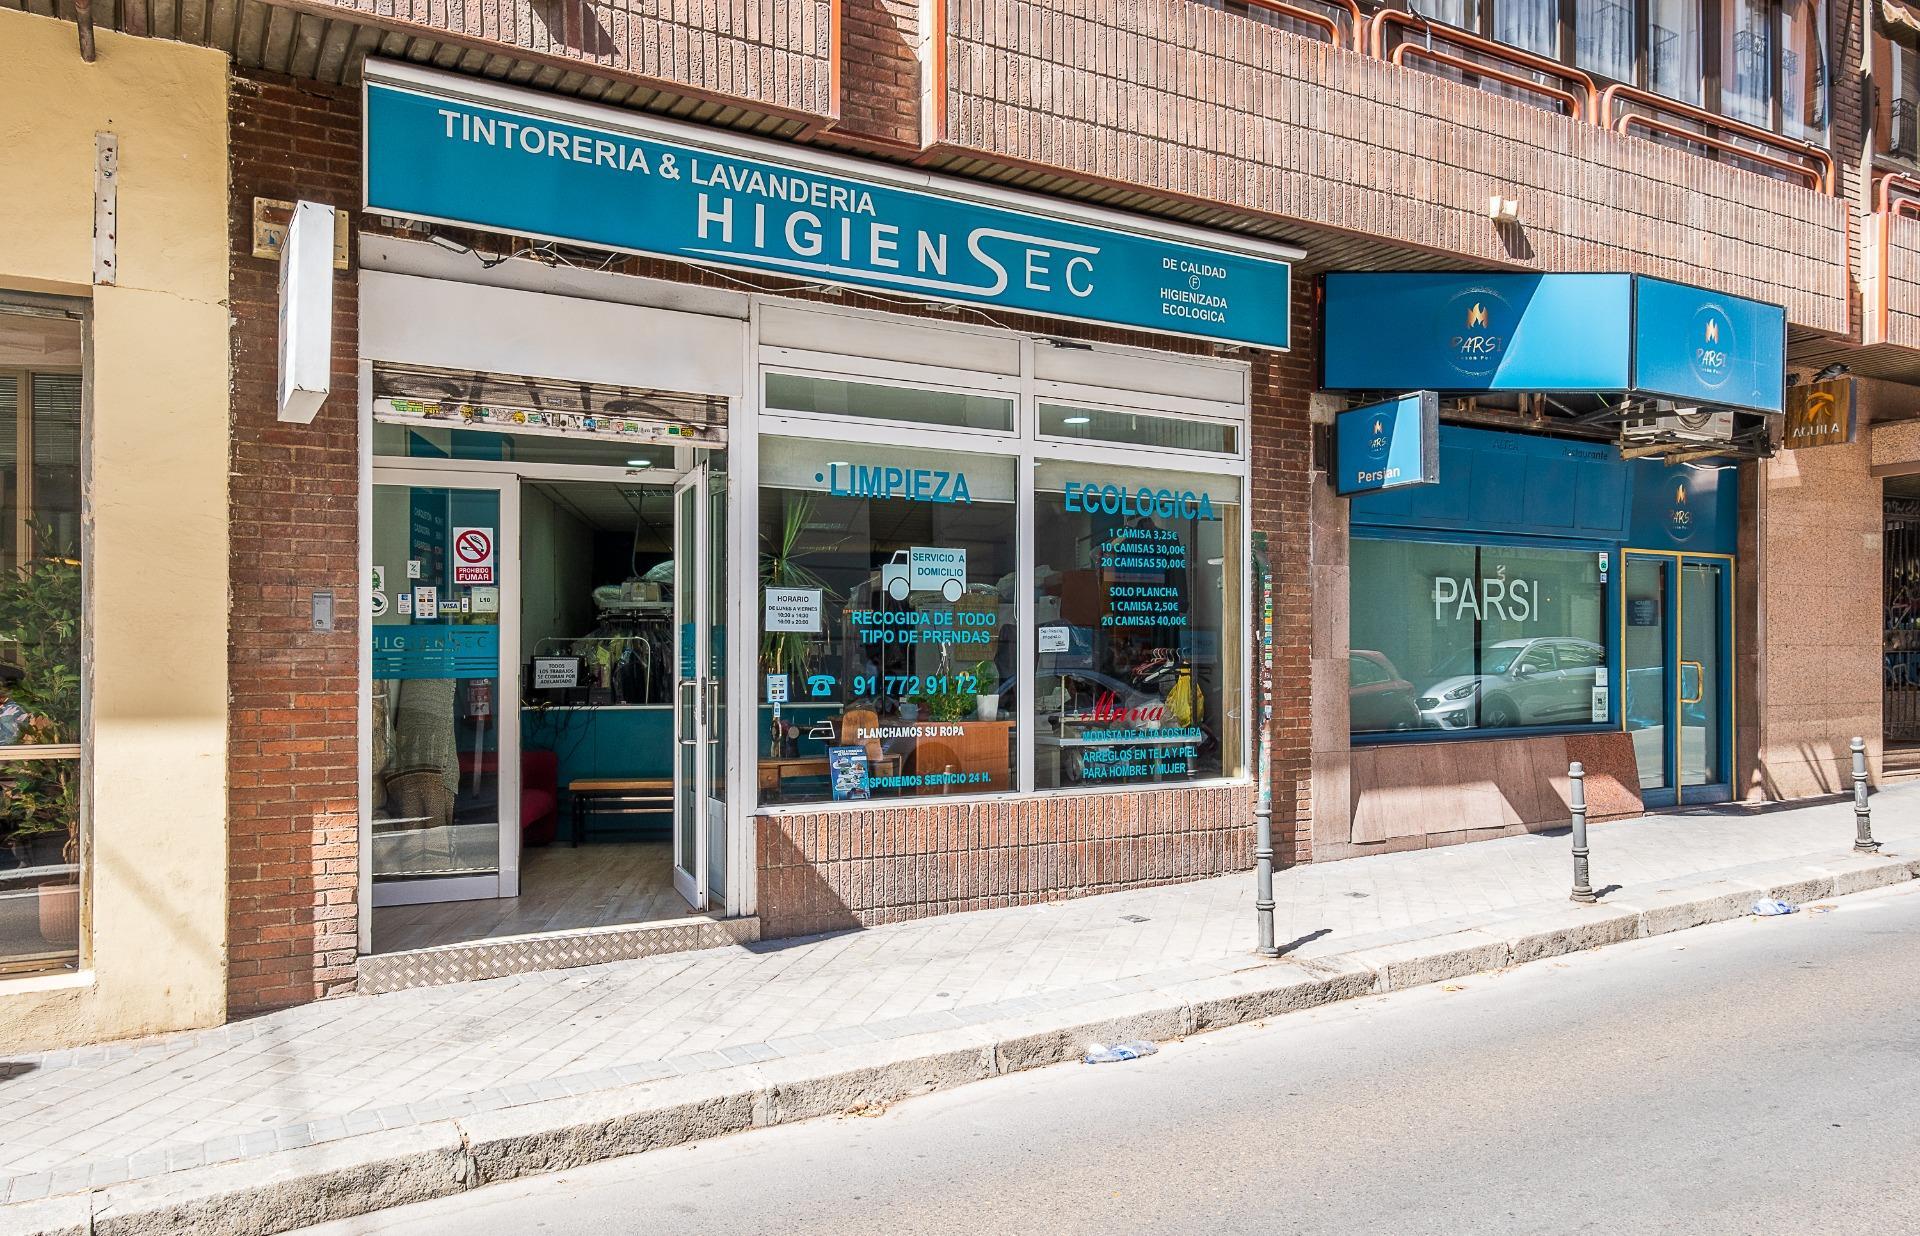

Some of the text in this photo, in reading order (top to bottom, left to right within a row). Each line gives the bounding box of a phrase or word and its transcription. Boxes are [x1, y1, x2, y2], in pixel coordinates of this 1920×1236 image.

[438, 109, 876, 216] TINTORERIA & LAVANDERIA
[1163, 257, 1227, 279] DE CALIDAD
[1160, 288, 1228, 309] HIGIENIZADA
[1162, 303, 1225, 323] ECOLOGICA
[1358, 467, 1400, 483] Persian
[831, 464, 972, 504] LIMPIEZA
[1065, 481, 1215, 521] ECOLOGICA
[1109, 528, 1178, 540] 1 CAMISA 3,25€
[1101, 543, 1186, 555] 10 CAMISAS 30,00€
[912, 552, 965, 563] SERVICIO A
[1101, 557, 1186, 569] 20 CAMISAS 50,00€
[459, 573, 489, 581] FUMAR
[917, 567, 964, 577] DOMICILIO
[1110, 587, 1178, 597] SOLO PLANCHA
[1435, 577, 1538, 621] PARSI
[1110, 601, 1179, 612] 1 CAMISA 2,50€
[852, 611, 996, 626] RECOGIDA DE TODO
[1102, 616, 1187, 627] 20 CAMISAS 40,00€
[860, 630, 990, 644] TIPO DE PRENDAS
[853, 675, 977, 695] 91 772 91 72
[857, 726, 965, 739] PLANCHAMOS SU ROPA
[1083, 727, 1201, 741] MODISTA DE ALTA COSTURA
[1083, 747, 1198, 762] ARREGLOS EN TELA Y PIEL
[1083, 763, 1186, 778] PARA HOMBRE Y MUJER
[924, 773, 966, 786] SERVICIO
[968, 772, 981, 784] 24
